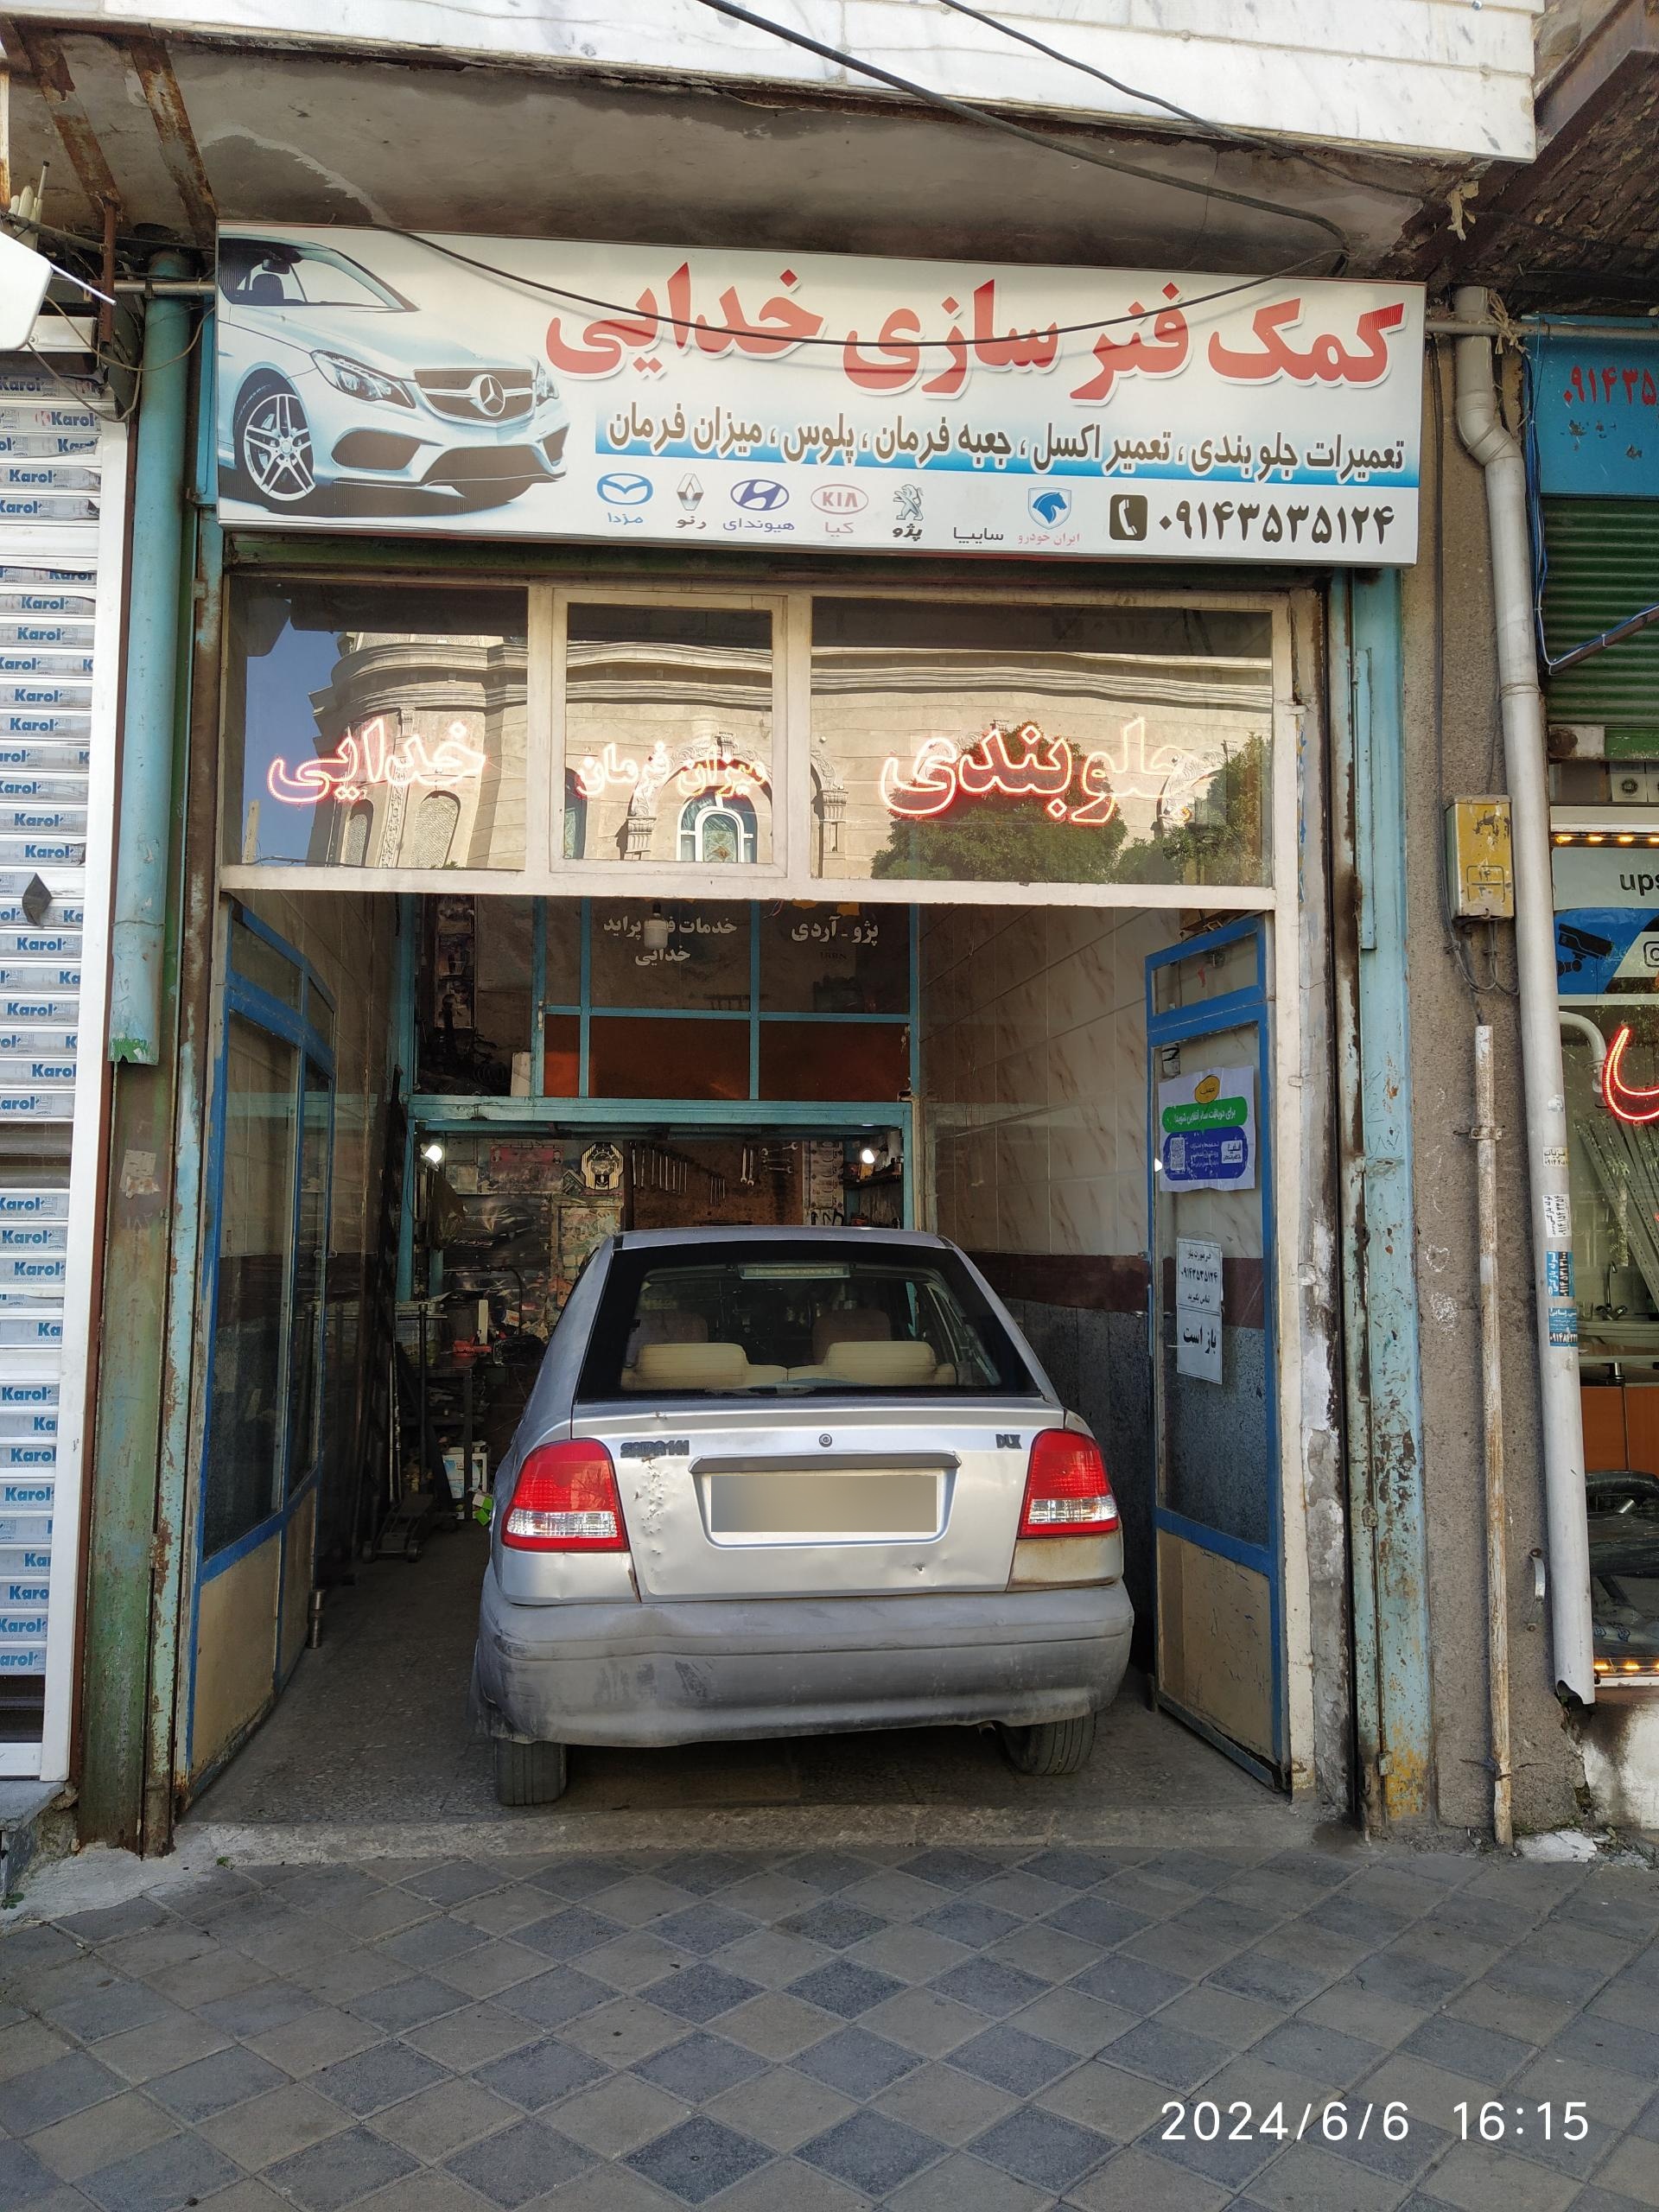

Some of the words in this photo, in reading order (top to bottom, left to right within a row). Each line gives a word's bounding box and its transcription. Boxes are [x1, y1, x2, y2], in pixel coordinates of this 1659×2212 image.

[545, 261, 825, 376] خدایی
[842, 278, 1059, 397] سازی
[1069, 281, 1192, 402] فنر
[1209, 297, 1405, 385] کمک
[51, 411, 95, 427] Karol
[609, 402, 686, 454] فرمان
[695, 406, 763, 455] میزان
[958, 422, 1012, 467] جعبه
[1107, 430, 1172, 474] تعمیر
[1306, 434, 1404, 482] تعمیرات
[9, 468, 54, 484] Karol
[822, 491, 859, 508] KIA
[607, 512, 645, 526] مزدا
[675, 515, 707, 530] رنو
[721, 517, 796, 534] هیوندای
[1158, 499, 1396, 546] ۰۹۱۴۳۵۳۵۱۲۴
[823, 521, 855, 538] کیا
[891, 522, 923, 542] پژو
[952, 526, 1005, 545] سایپا
[1017, 531, 1051, 546] خودرو
[1052, 532, 1080, 546] ایران
[21, 596, 65, 610] Karol
[17, 626, 62, 641] Karol
[14, 689, 59, 702] Karol
[10, 717, 54, 732] Karol
[266, 717, 488, 807] خدایی
[14, 812, 60, 828] Karol
[24, 844, 70, 859] Karol
[602, 914, 642, 940] پراید
[678, 916, 738, 934] خدمات
[791, 914, 842, 943] آردی
[850, 919, 879, 947] پژو
[16, 937, 62, 951] Karol
[634, 944, 691, 966] خدایی
[7, 1002, 54, 1017] Karol
[0, 1096, 35, 1110] arol
[2, 1230, 48, 1244] Karol
[14, 1262, 60, 1276] Karol
[2, 1387, 48, 1402] Karol
[995, 1433, 1023, 1450] DLX
[10, 1447, 56, 1463] Karol
[4, 1486, 51, 1502] Karol
[10, 1586, 49, 1600] Karo
[0, 1651, 34, 1667] arol
